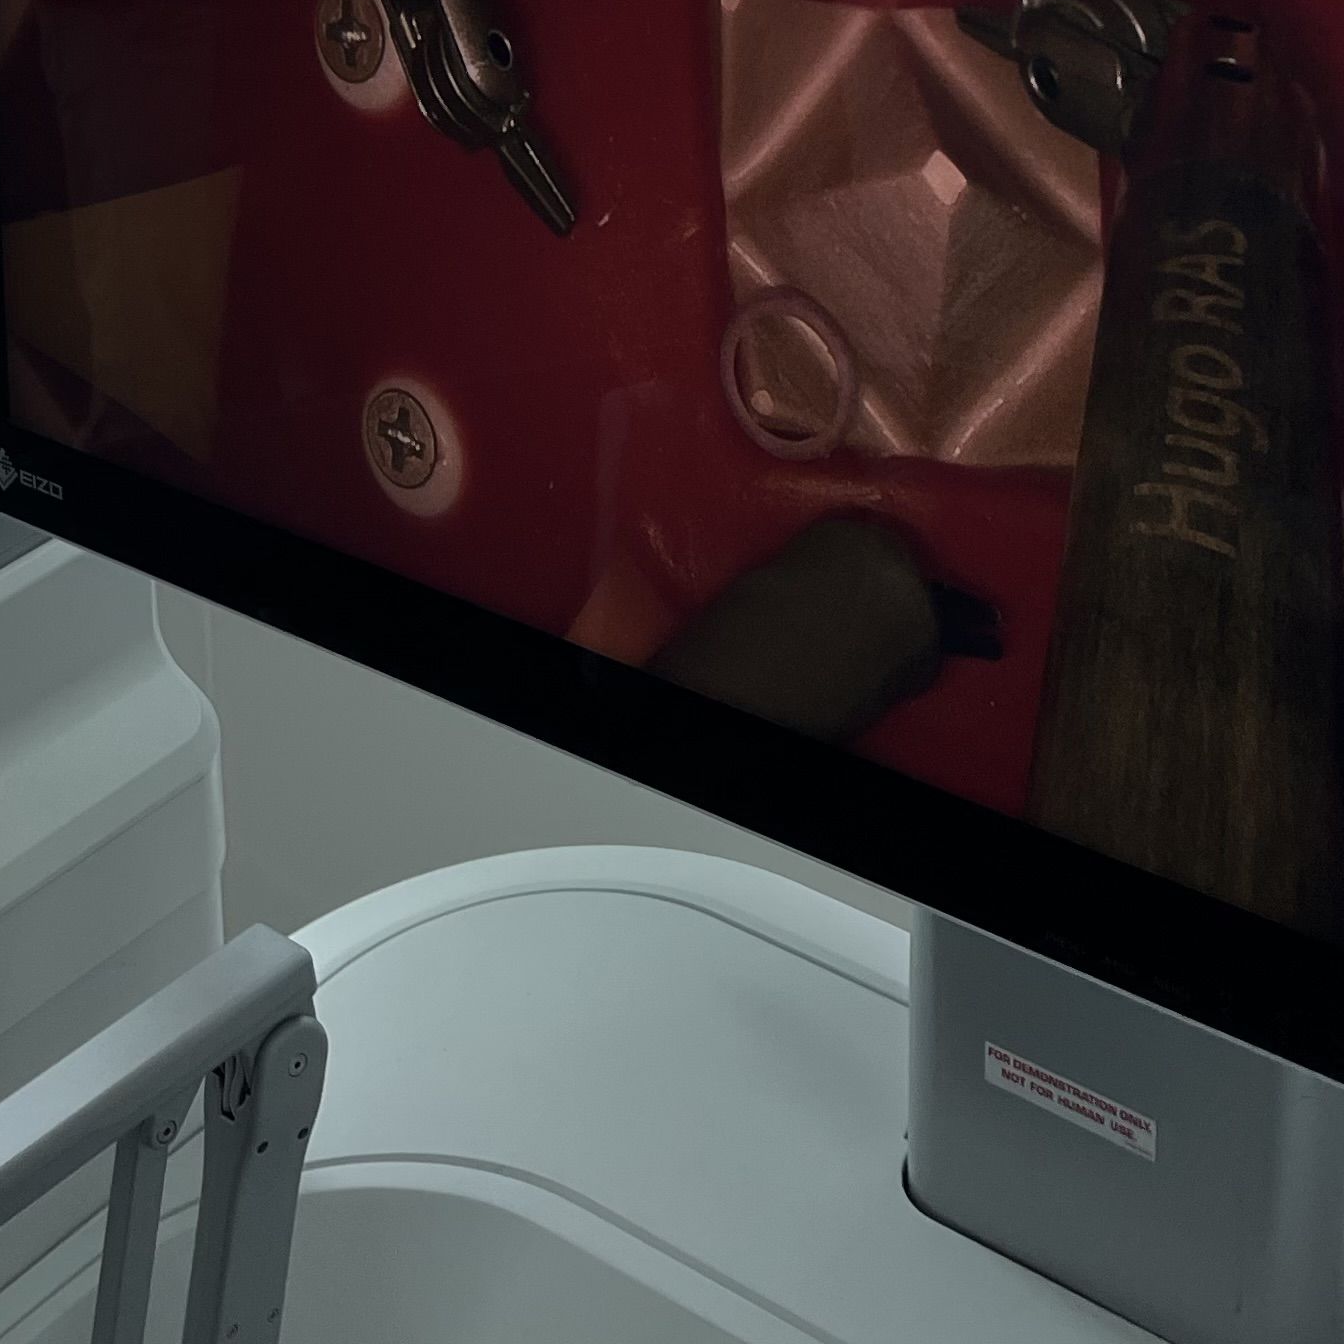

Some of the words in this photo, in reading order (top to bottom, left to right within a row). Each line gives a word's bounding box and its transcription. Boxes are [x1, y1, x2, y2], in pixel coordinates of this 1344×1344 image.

[19, 469, 64, 501] EIZO
[1128, 344, 1271, 557] Hugo
[988, 1046, 1011, 1066] FOR
[1012, 1059, 1119, 1117] DEMONSTRATION
[1119, 1110, 1153, 1134] ONLY.
[1000, 1067, 1026, 1088] NOT
[1029, 1080, 1055, 1102] FOR
[1056, 1094, 1106, 1127] HUMAN
